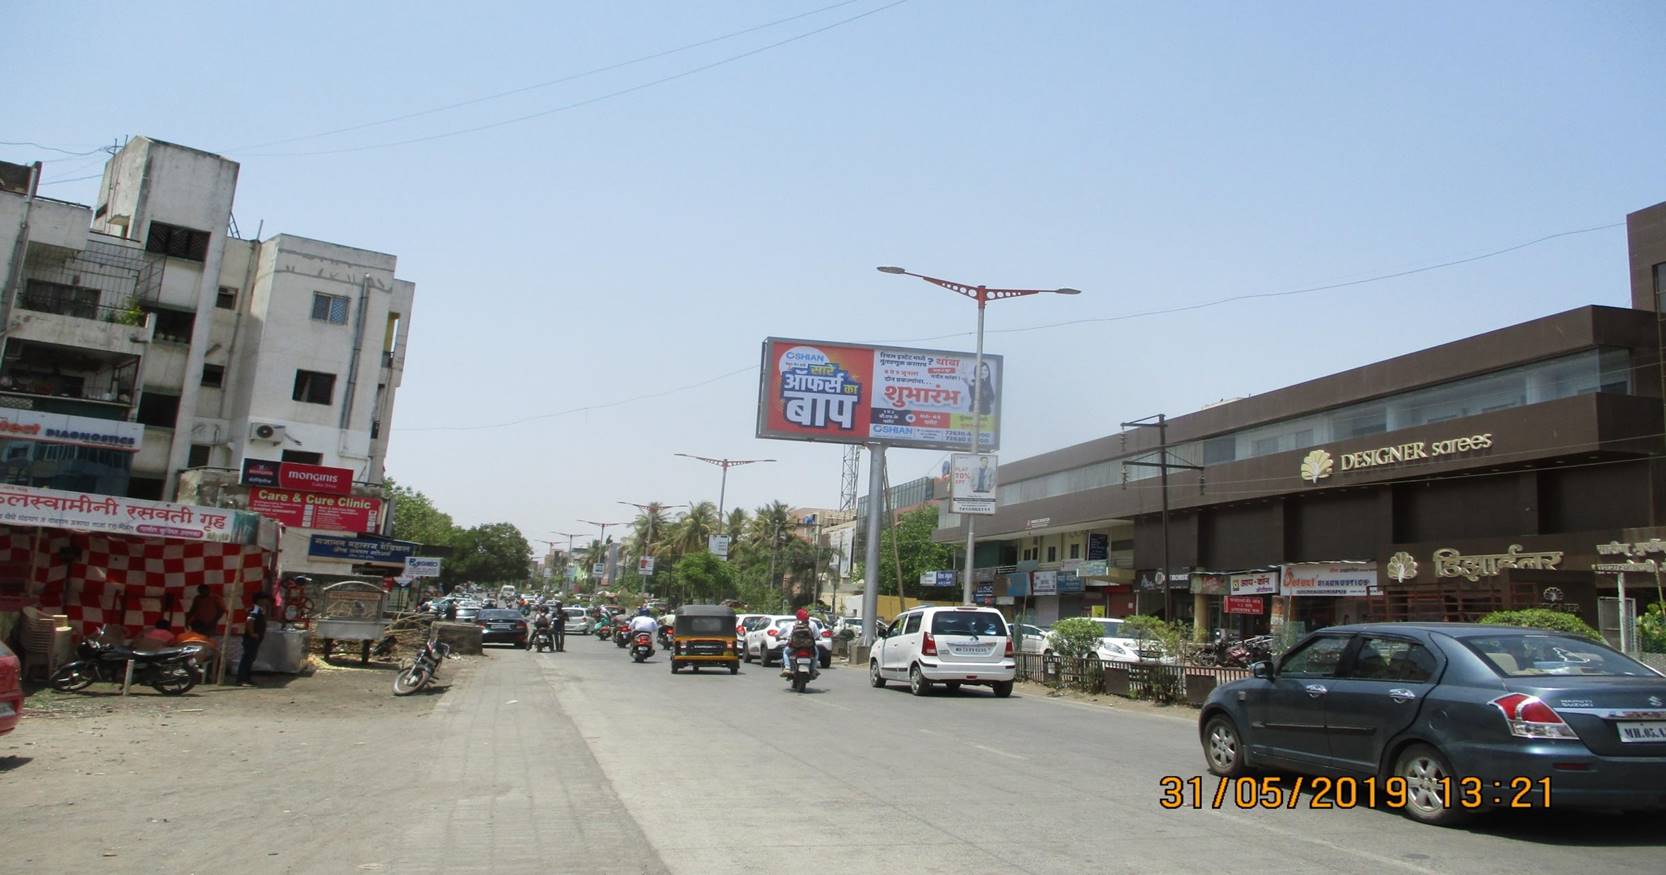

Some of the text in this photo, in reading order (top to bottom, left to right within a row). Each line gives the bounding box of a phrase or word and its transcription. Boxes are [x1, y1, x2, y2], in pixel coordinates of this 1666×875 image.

[784, 368, 845, 394] ऑफर्स
[884, 384, 961, 408] शुभारंभ
[784, 391, 858, 429] बाप
[46, 428, 135, 445] DIAGNOSTICS
[1340, 433, 1493, 472] DESIGNER sarees
[258, 489, 371, 510] Care & Cure Clinic
[200, 513, 227, 531] गृह
[1317, 578, 1370, 587] DIAGNOSTICS
